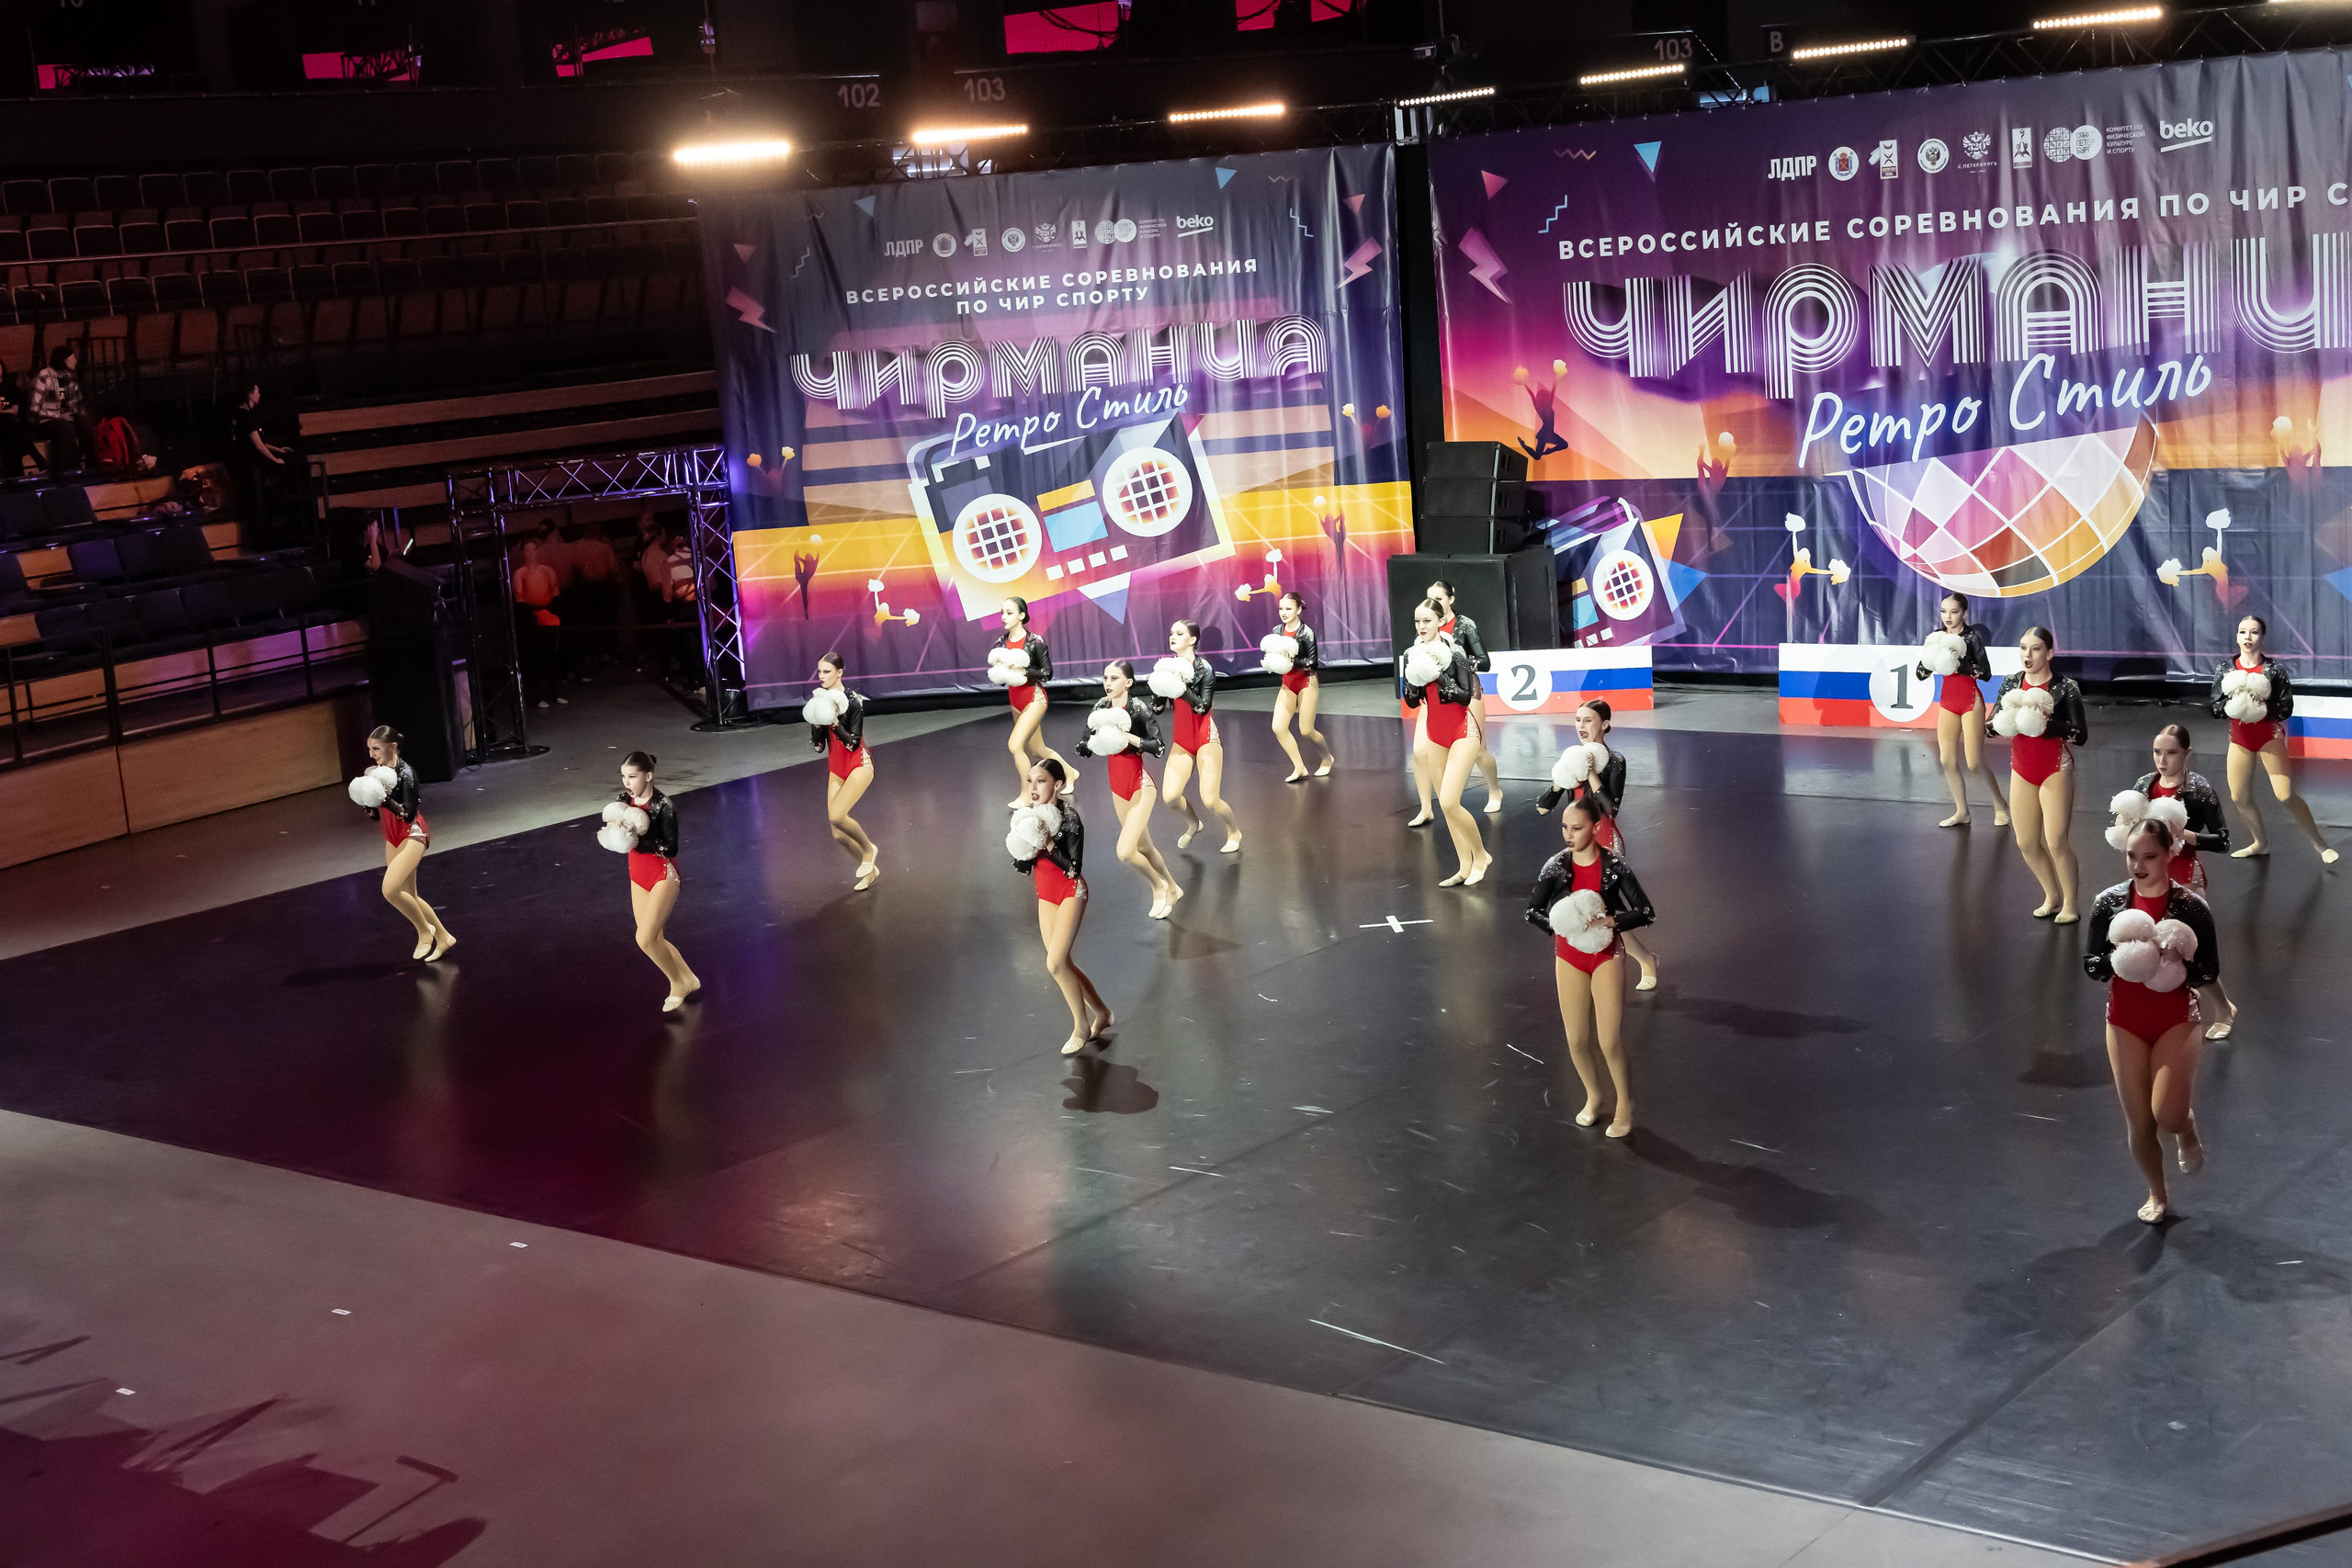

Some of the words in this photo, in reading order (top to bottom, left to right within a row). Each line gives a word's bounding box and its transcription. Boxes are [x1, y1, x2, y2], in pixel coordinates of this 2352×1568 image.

[1655, 38, 1692, 61] 103
[837, 83, 880, 107] 102
[965, 77, 1005, 102] 103
[2106, 130, 2146, 140] ФИЗИЧЕСКОЙ
[2160, 118, 2214, 140] beko
[1768, 155, 1817, 181] ЛДПР
[1176, 215, 1215, 229] beko
[1559, 221, 1831, 260] ВСЕРОССИЙСКИЕ
[1847, 197, 2140, 239] СОРЕВНОВАНИЯ
[2160, 192, 2210, 217] ПО
[2229, 186, 2307, 211] ЧИР
[884, 239, 924, 258] ЛДПР
[846, 275, 1051, 304] ВСЕРОССИЙСКИЕ
[1062, 259, 1257, 287] СОРЕВНОВАНИЯ
[956, 299, 988, 315] ПО
[999, 295, 1046, 311] ЧИР
[1057, 287, 1148, 307] СПОРТУ
[950, 411, 1061, 457] Ретро
[1076, 384, 1189, 429] Стиль
[1798, 392, 1983, 468] Ретро
[2008, 353, 2212, 430] Стиль
[1510, 664, 1537, 701] 2
[1890, 664, 1914, 709] 1
